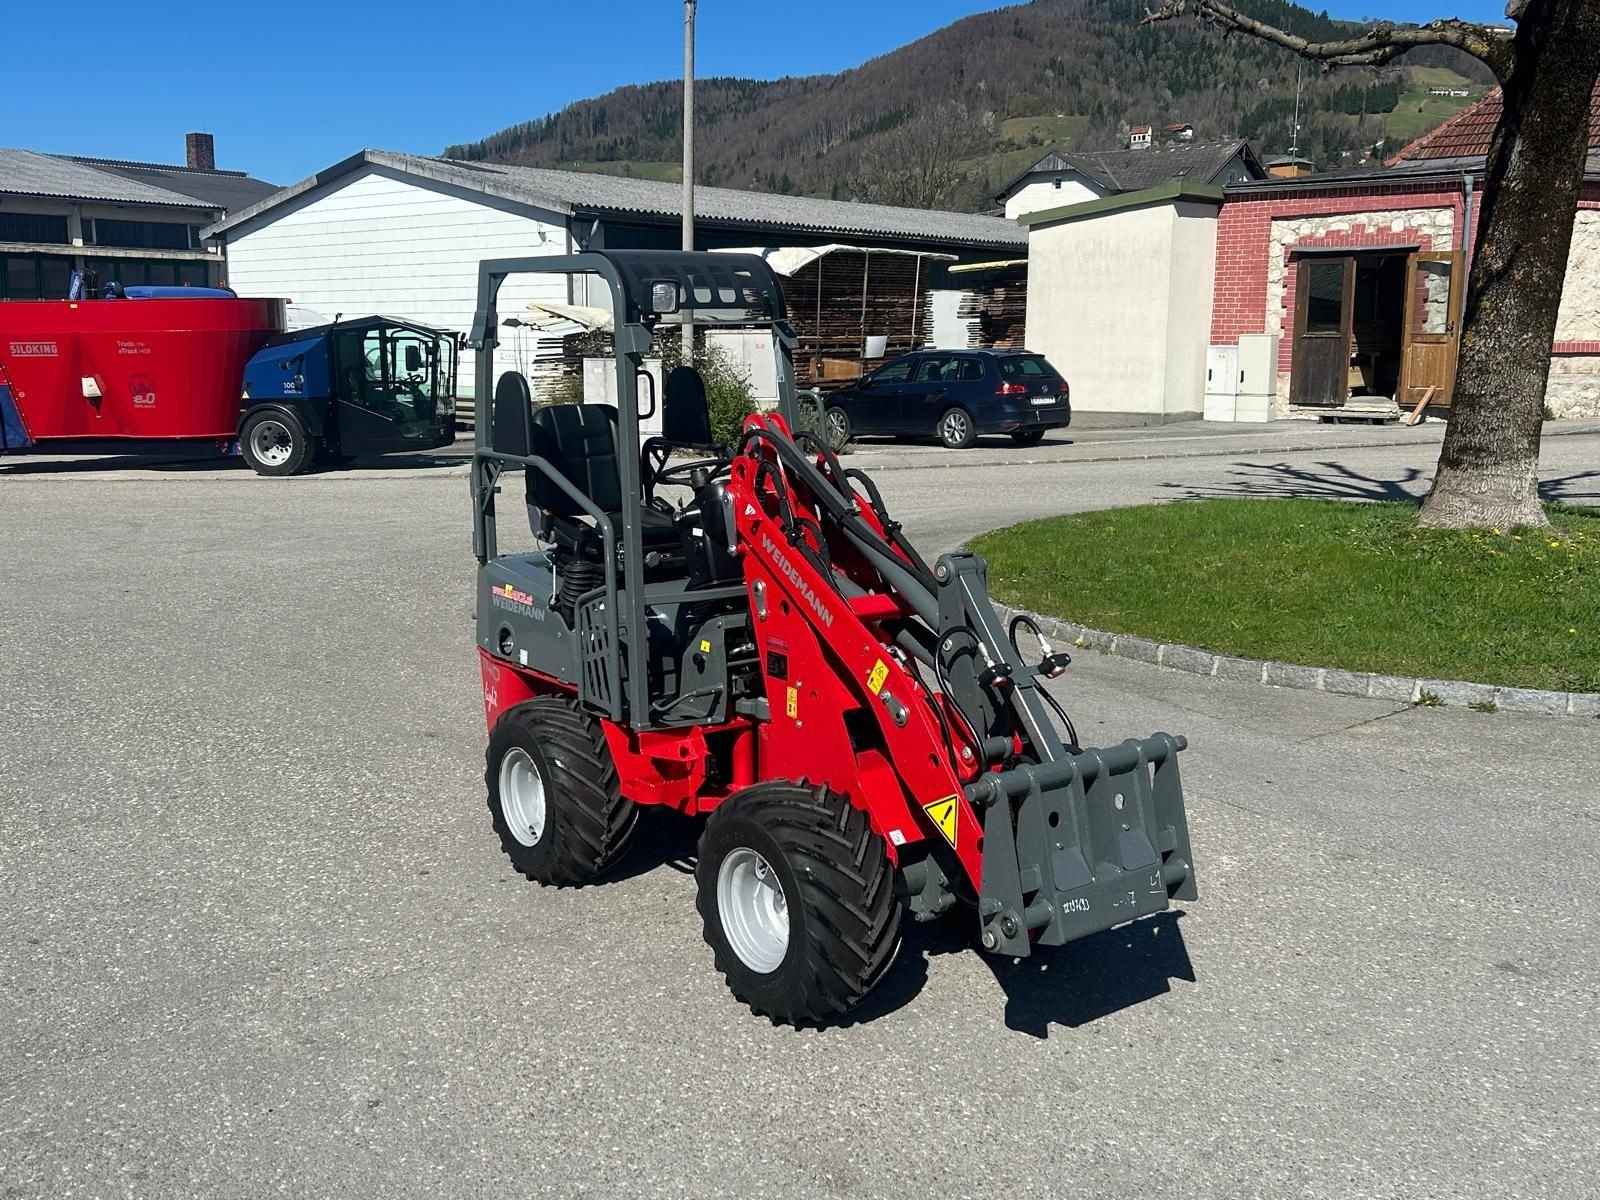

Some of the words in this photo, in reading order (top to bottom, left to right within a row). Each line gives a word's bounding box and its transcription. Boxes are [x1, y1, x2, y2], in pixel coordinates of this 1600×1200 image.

[10, 343, 58, 355] SILOKING
[762, 532, 834, 628] WEIDEMANN
[492, 594, 545, 622] WEIDEMANN
